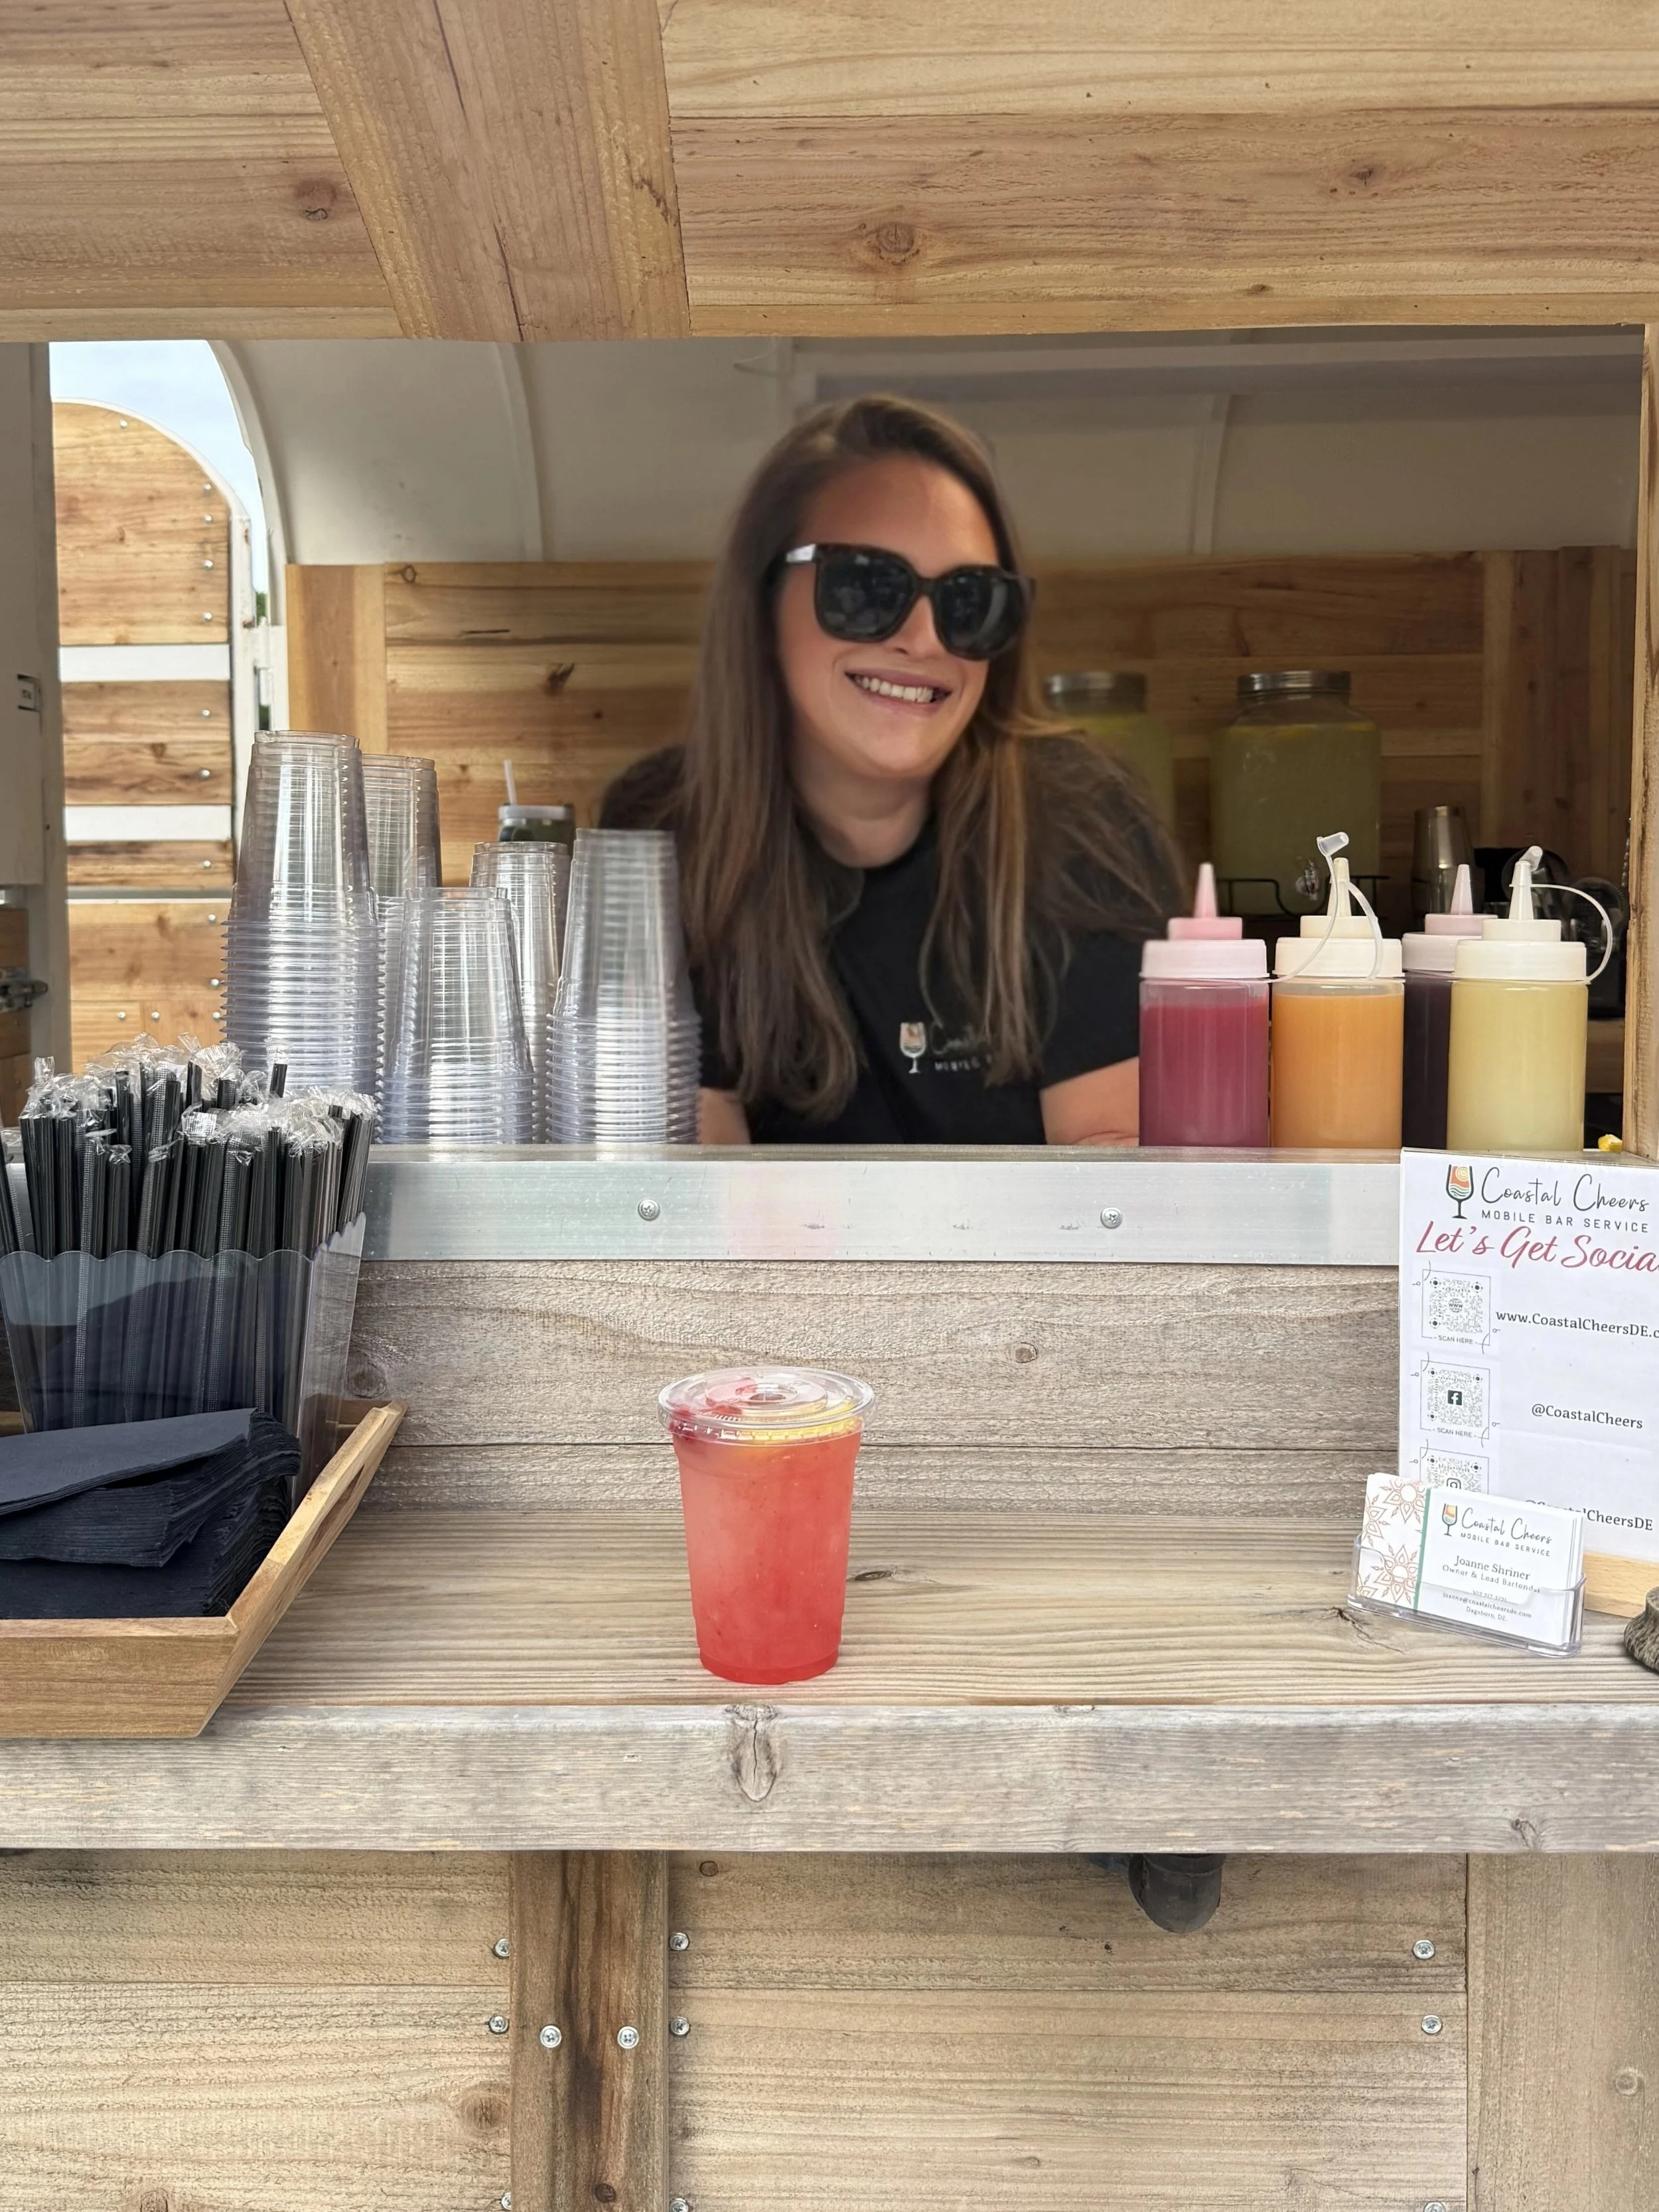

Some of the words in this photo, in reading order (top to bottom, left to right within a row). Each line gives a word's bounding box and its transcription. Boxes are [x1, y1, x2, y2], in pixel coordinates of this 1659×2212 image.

[1481, 1167, 1561, 1207] Coastal
[1573, 1174, 1650, 1212] Cheers
[1481, 1210, 1535, 1223] MOBILE
[1546, 1216, 1573, 1226] BAR
[1584, 1218, 1648, 1233] SERVICE
[1416, 1220, 1495, 1255] Let's
[1500, 1226, 1558, 1270] Get
[1561, 1235, 1659, 1272] Socia
[1532, 1403, 1643, 1429] @CoastalCheers
[1462, 1507, 1505, 1535] Coastal
[1511, 1518, 1553, 1544] Cheers
[1461, 1532, 1490, 1544] MOBILE
[1515, 1544, 1550, 1557] SERVICE
[1443, 1564, 1468, 1576] Owner
[1454, 1556, 1489, 1571] Joanne
[1492, 1564, 1531, 1580] Shriner
